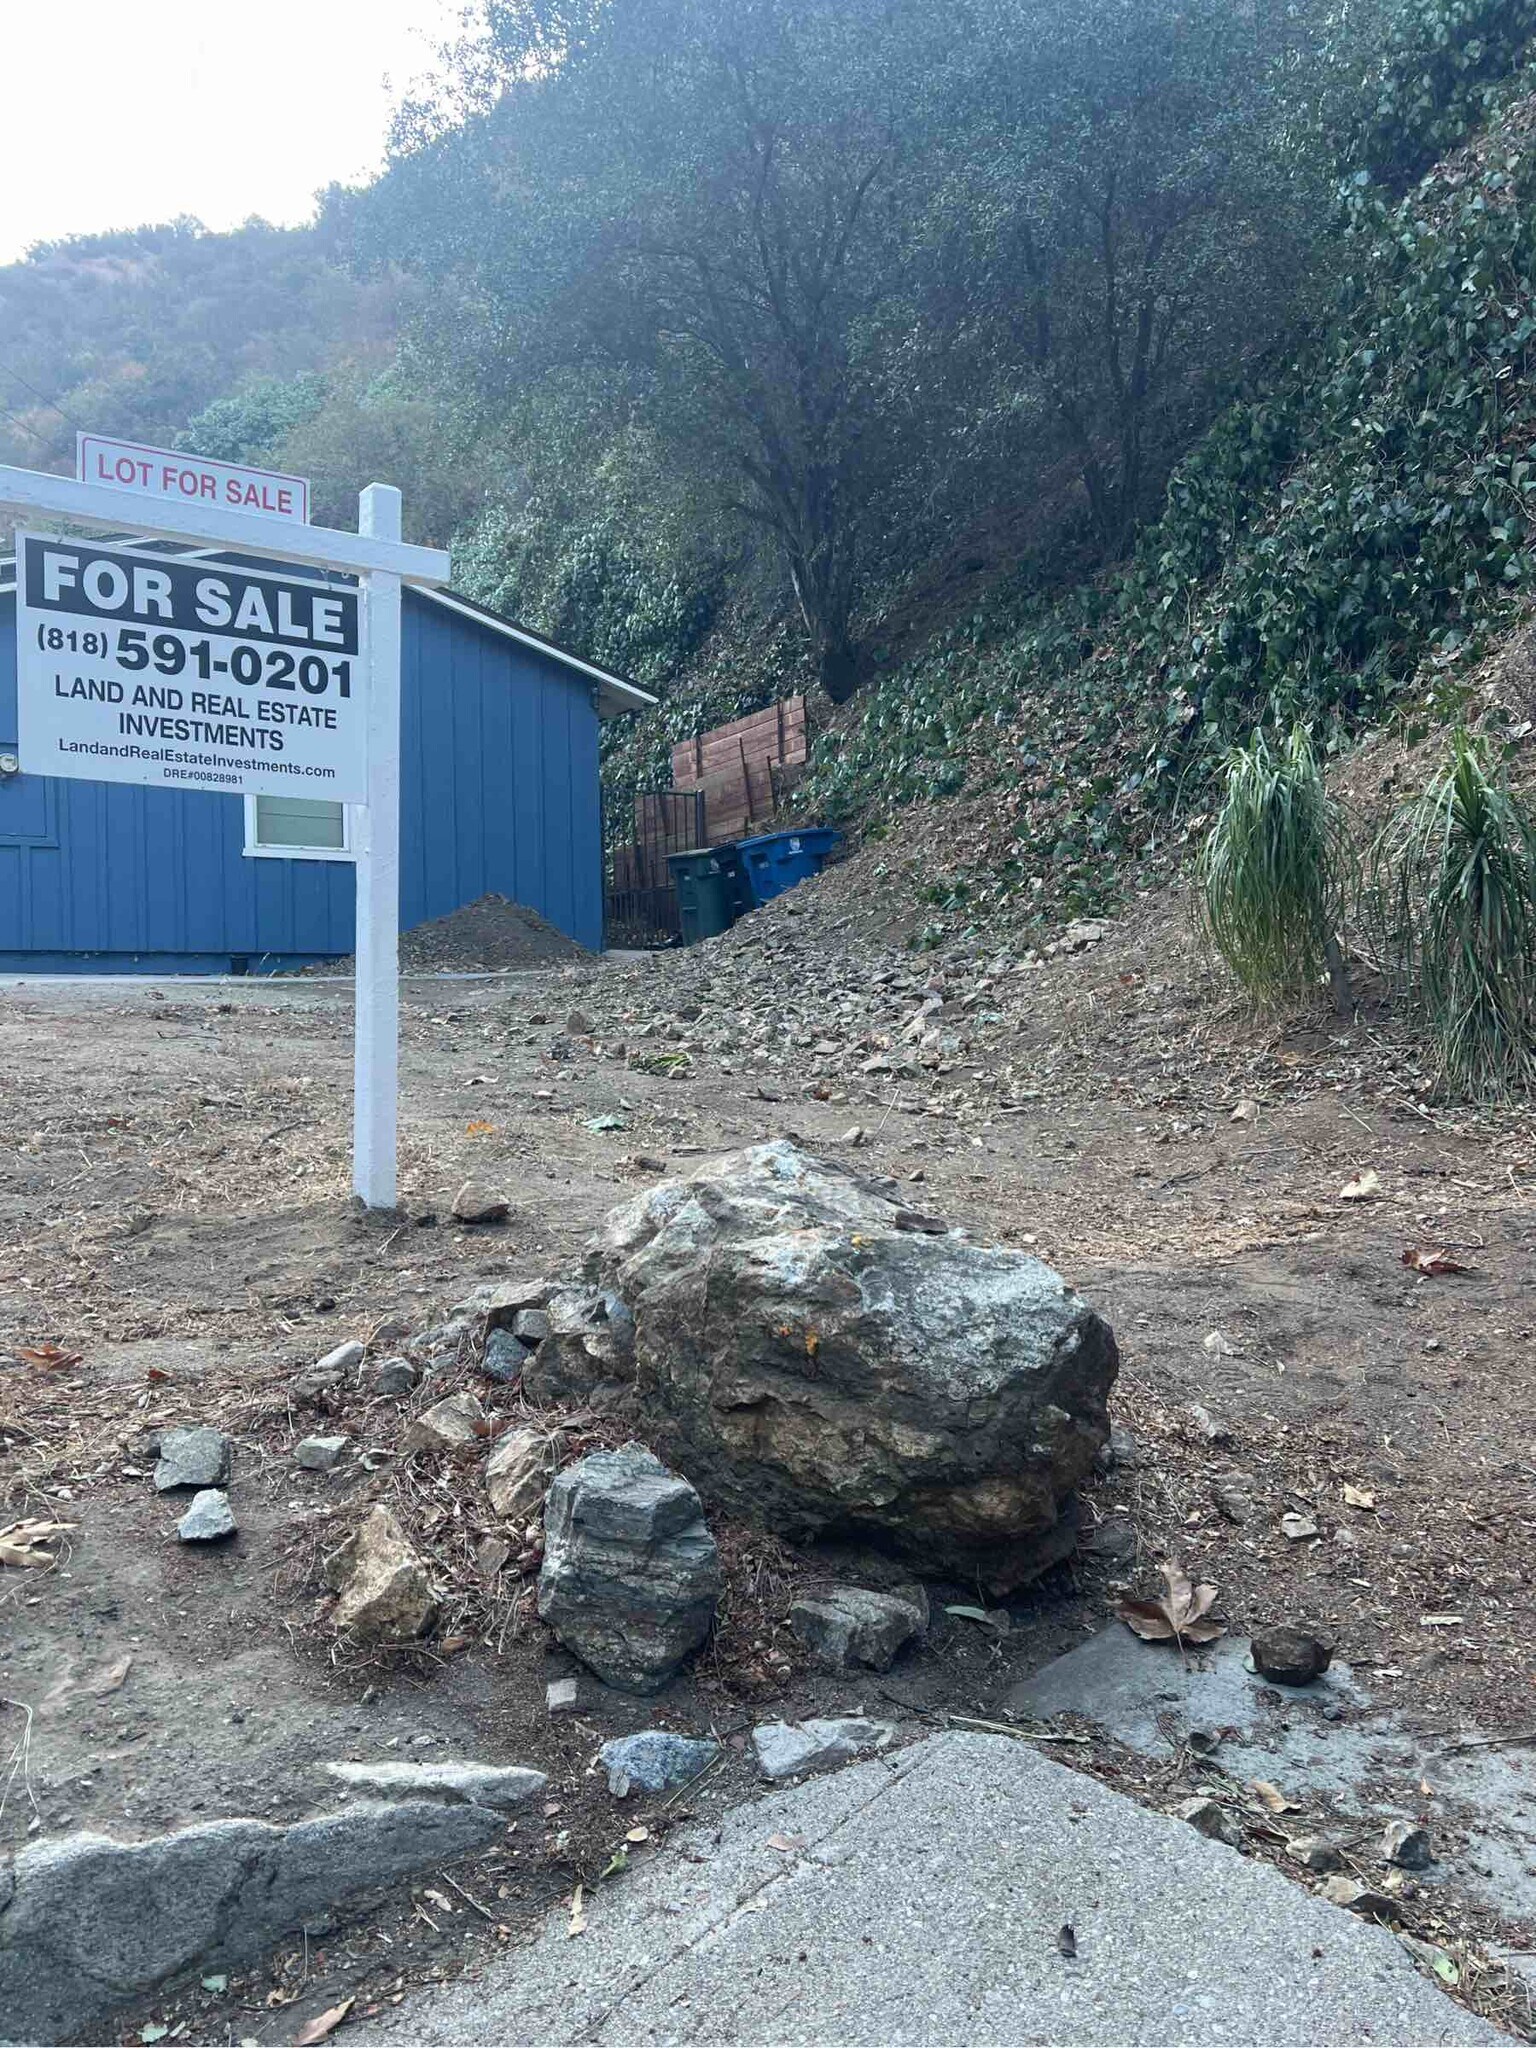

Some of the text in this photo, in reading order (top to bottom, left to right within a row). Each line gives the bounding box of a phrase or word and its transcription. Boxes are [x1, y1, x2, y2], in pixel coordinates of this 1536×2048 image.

[99, 454, 293, 514] LOT FOR SALE
[43, 551, 345, 645] FOR SALE
[38, 623, 352, 698] (818) 591-0201
[54, 674, 337, 729] LAND AND REAL ESTATE
[58, 738, 336, 778] LandandRealEstateInvestments.com
[118, 712, 285, 751] INVESTMENTS
[163, 768, 244, 785] DRE#00828981
